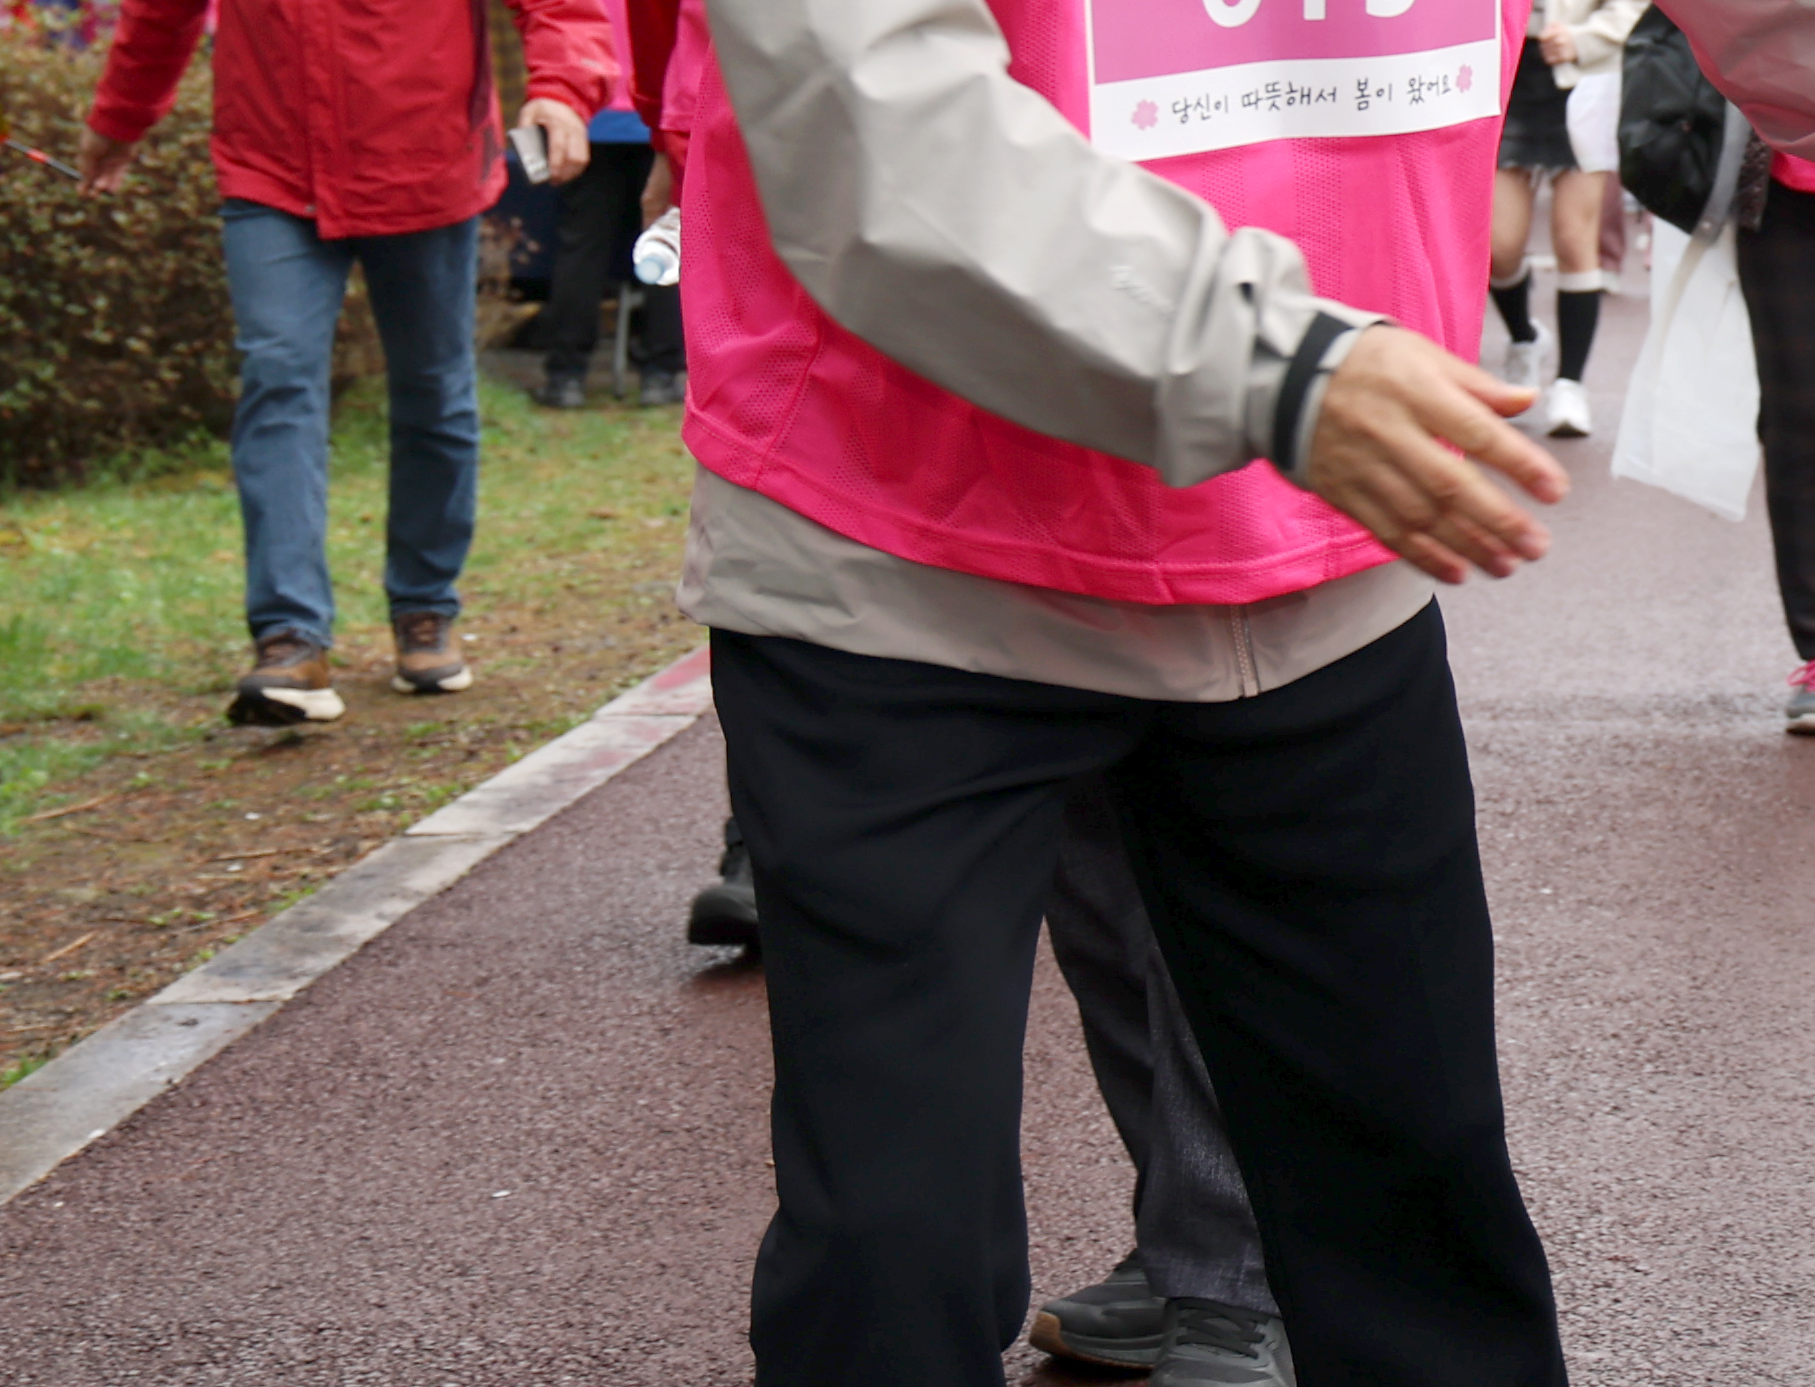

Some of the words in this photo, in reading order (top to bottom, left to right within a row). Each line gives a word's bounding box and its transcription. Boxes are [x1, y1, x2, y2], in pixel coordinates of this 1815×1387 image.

[1171, 95, 1230, 125] 당신이
[1241, 80, 1337, 112] 따뜻해서
[1354, 77, 1393, 111] 봄이
[1406, 75, 1452, 105] 왔어요
